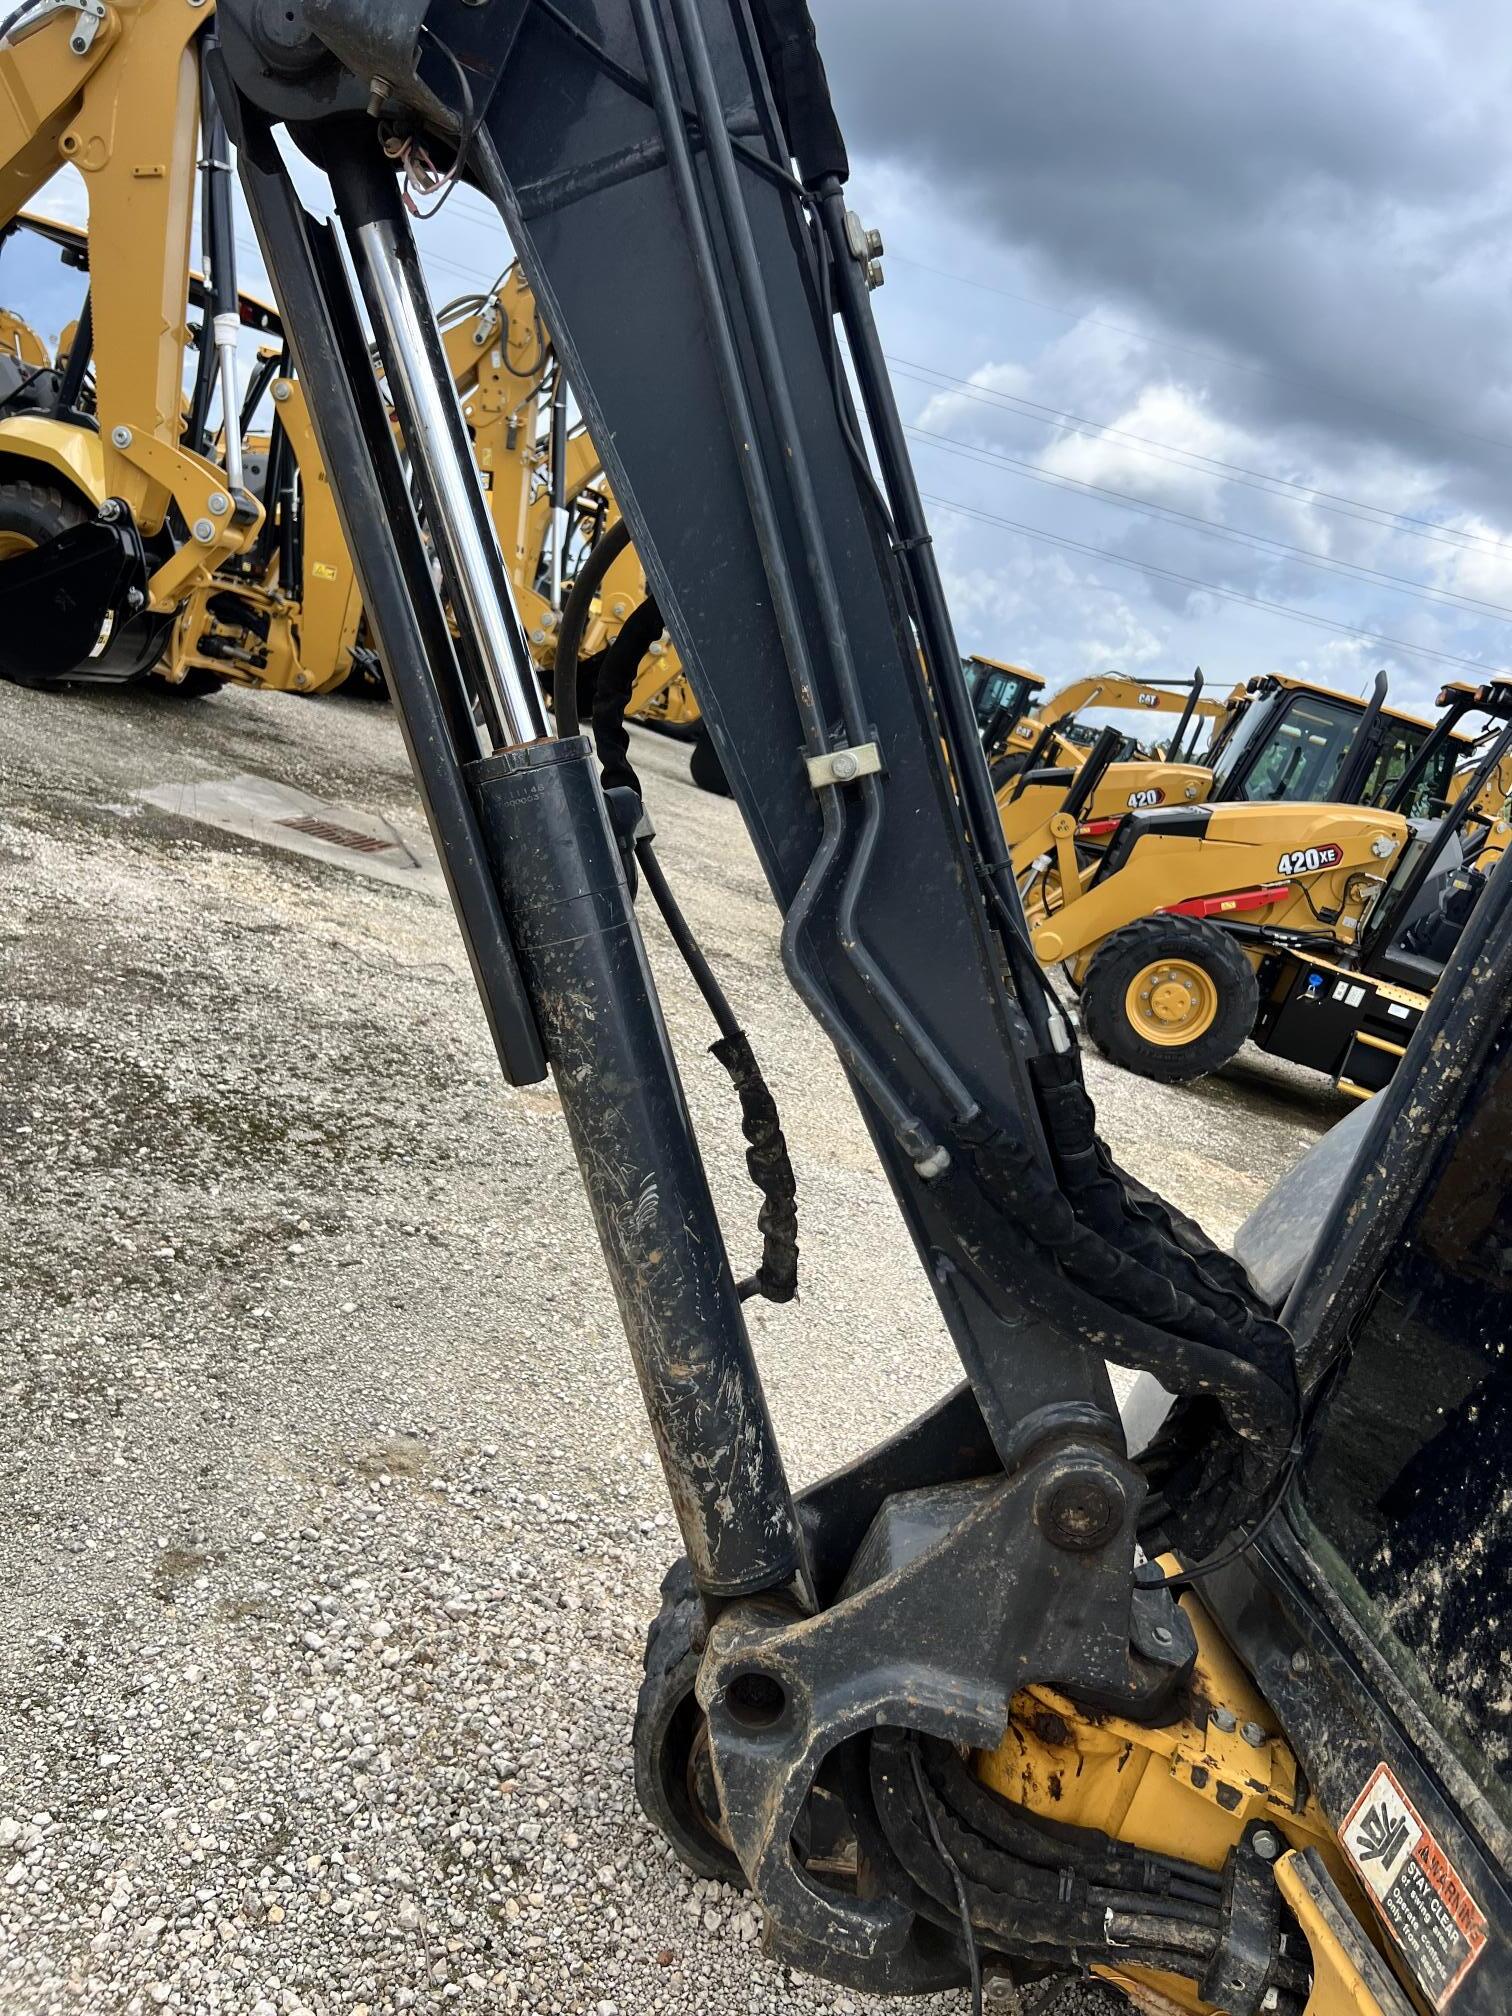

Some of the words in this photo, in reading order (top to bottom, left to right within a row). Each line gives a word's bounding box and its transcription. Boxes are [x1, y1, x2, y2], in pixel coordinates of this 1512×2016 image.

[1128, 789, 1156, 807] 420
[1387, 1899, 1402, 1923] only
[1403, 1924, 1420, 1951] from
[1401, 1875, 1410, 1887] of
[1411, 1891, 1431, 1924] swing
[1407, 1861, 1430, 1897] STAY
[1430, 1899, 1459, 1945] CLEAR
[1393, 1888, 1419, 1930] Operate
[1421, 1934, 1448, 1980] controls
